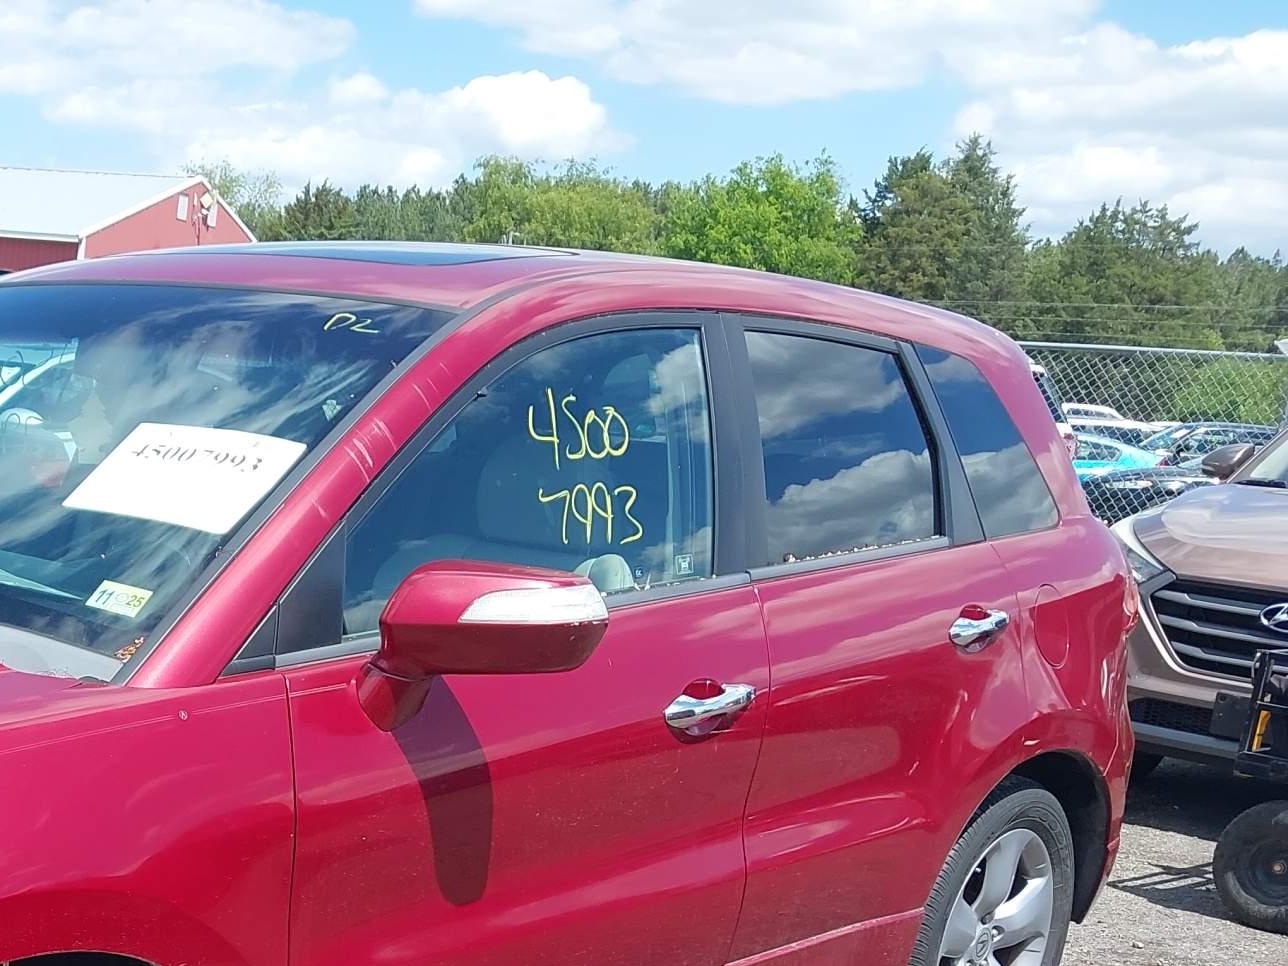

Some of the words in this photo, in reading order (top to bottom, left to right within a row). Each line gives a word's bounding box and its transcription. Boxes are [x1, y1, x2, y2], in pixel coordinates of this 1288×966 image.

[528, 386, 630, 471] 4500
[538, 481, 644, 545] 7993
[95, 588, 117, 606] 11
[125, 595, 145, 608] 25
